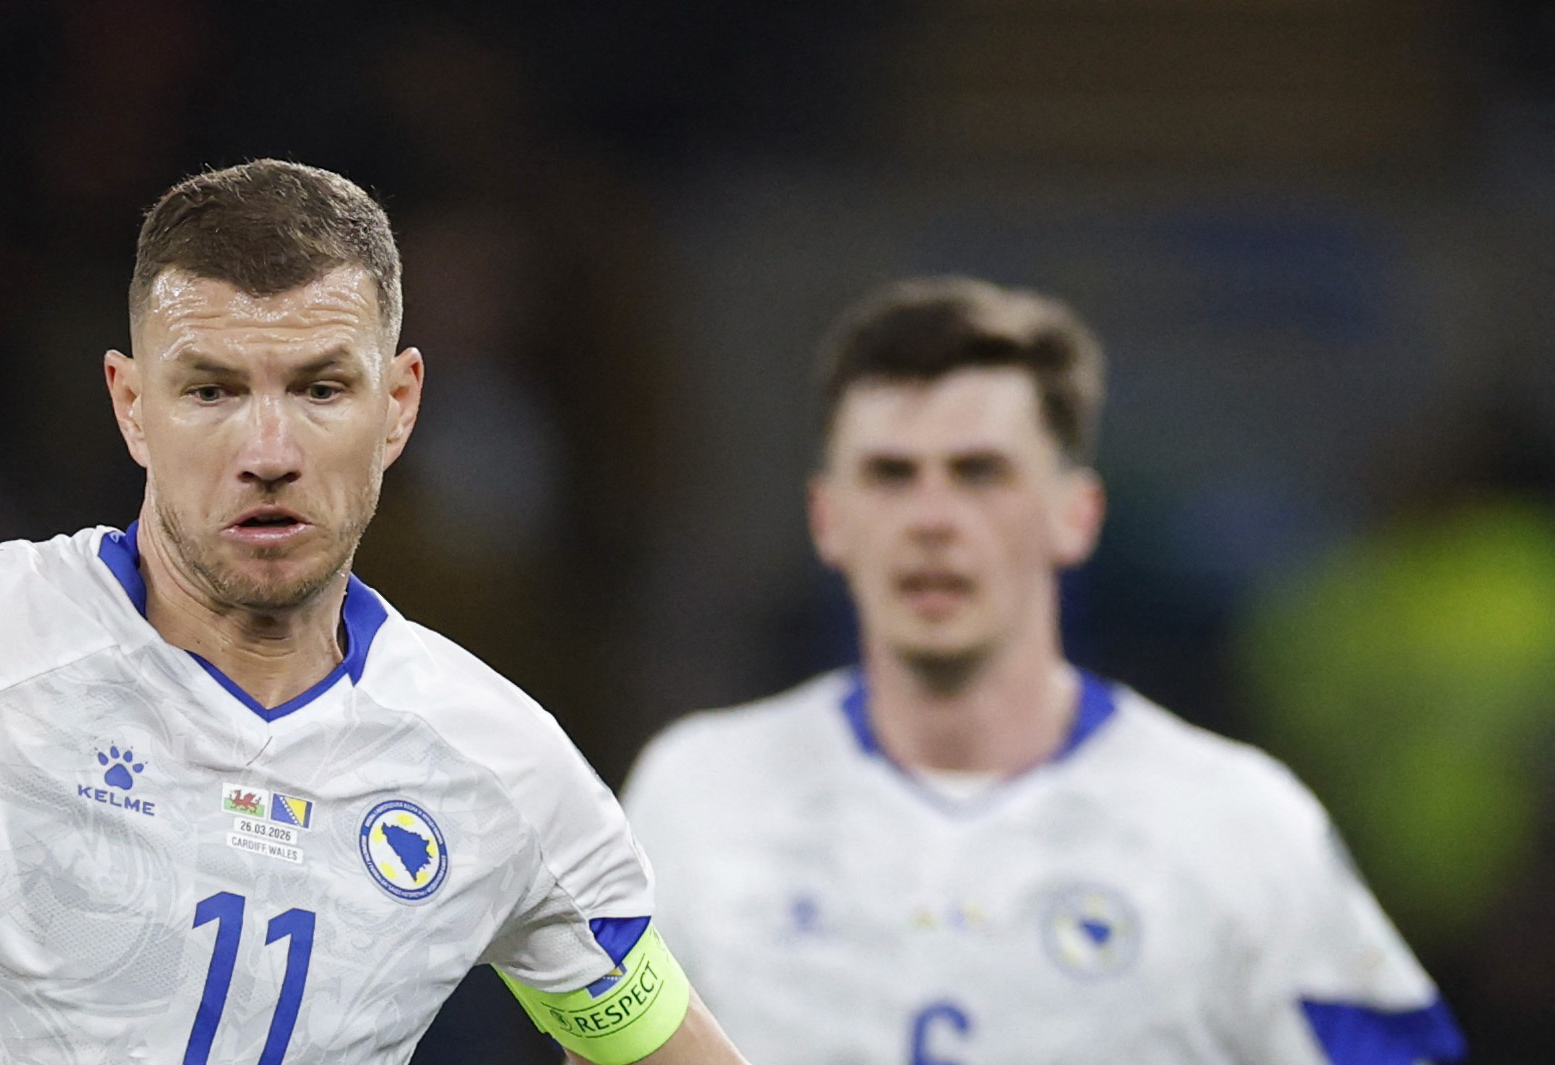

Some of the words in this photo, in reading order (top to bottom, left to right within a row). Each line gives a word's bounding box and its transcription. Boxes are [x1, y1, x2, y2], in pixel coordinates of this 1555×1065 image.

[77, 784, 155, 816] KELME
[240, 820, 292, 841] 26.03.2026
[268, 844, 298, 861] WALES
[574, 960, 658, 1032] RESPECT
